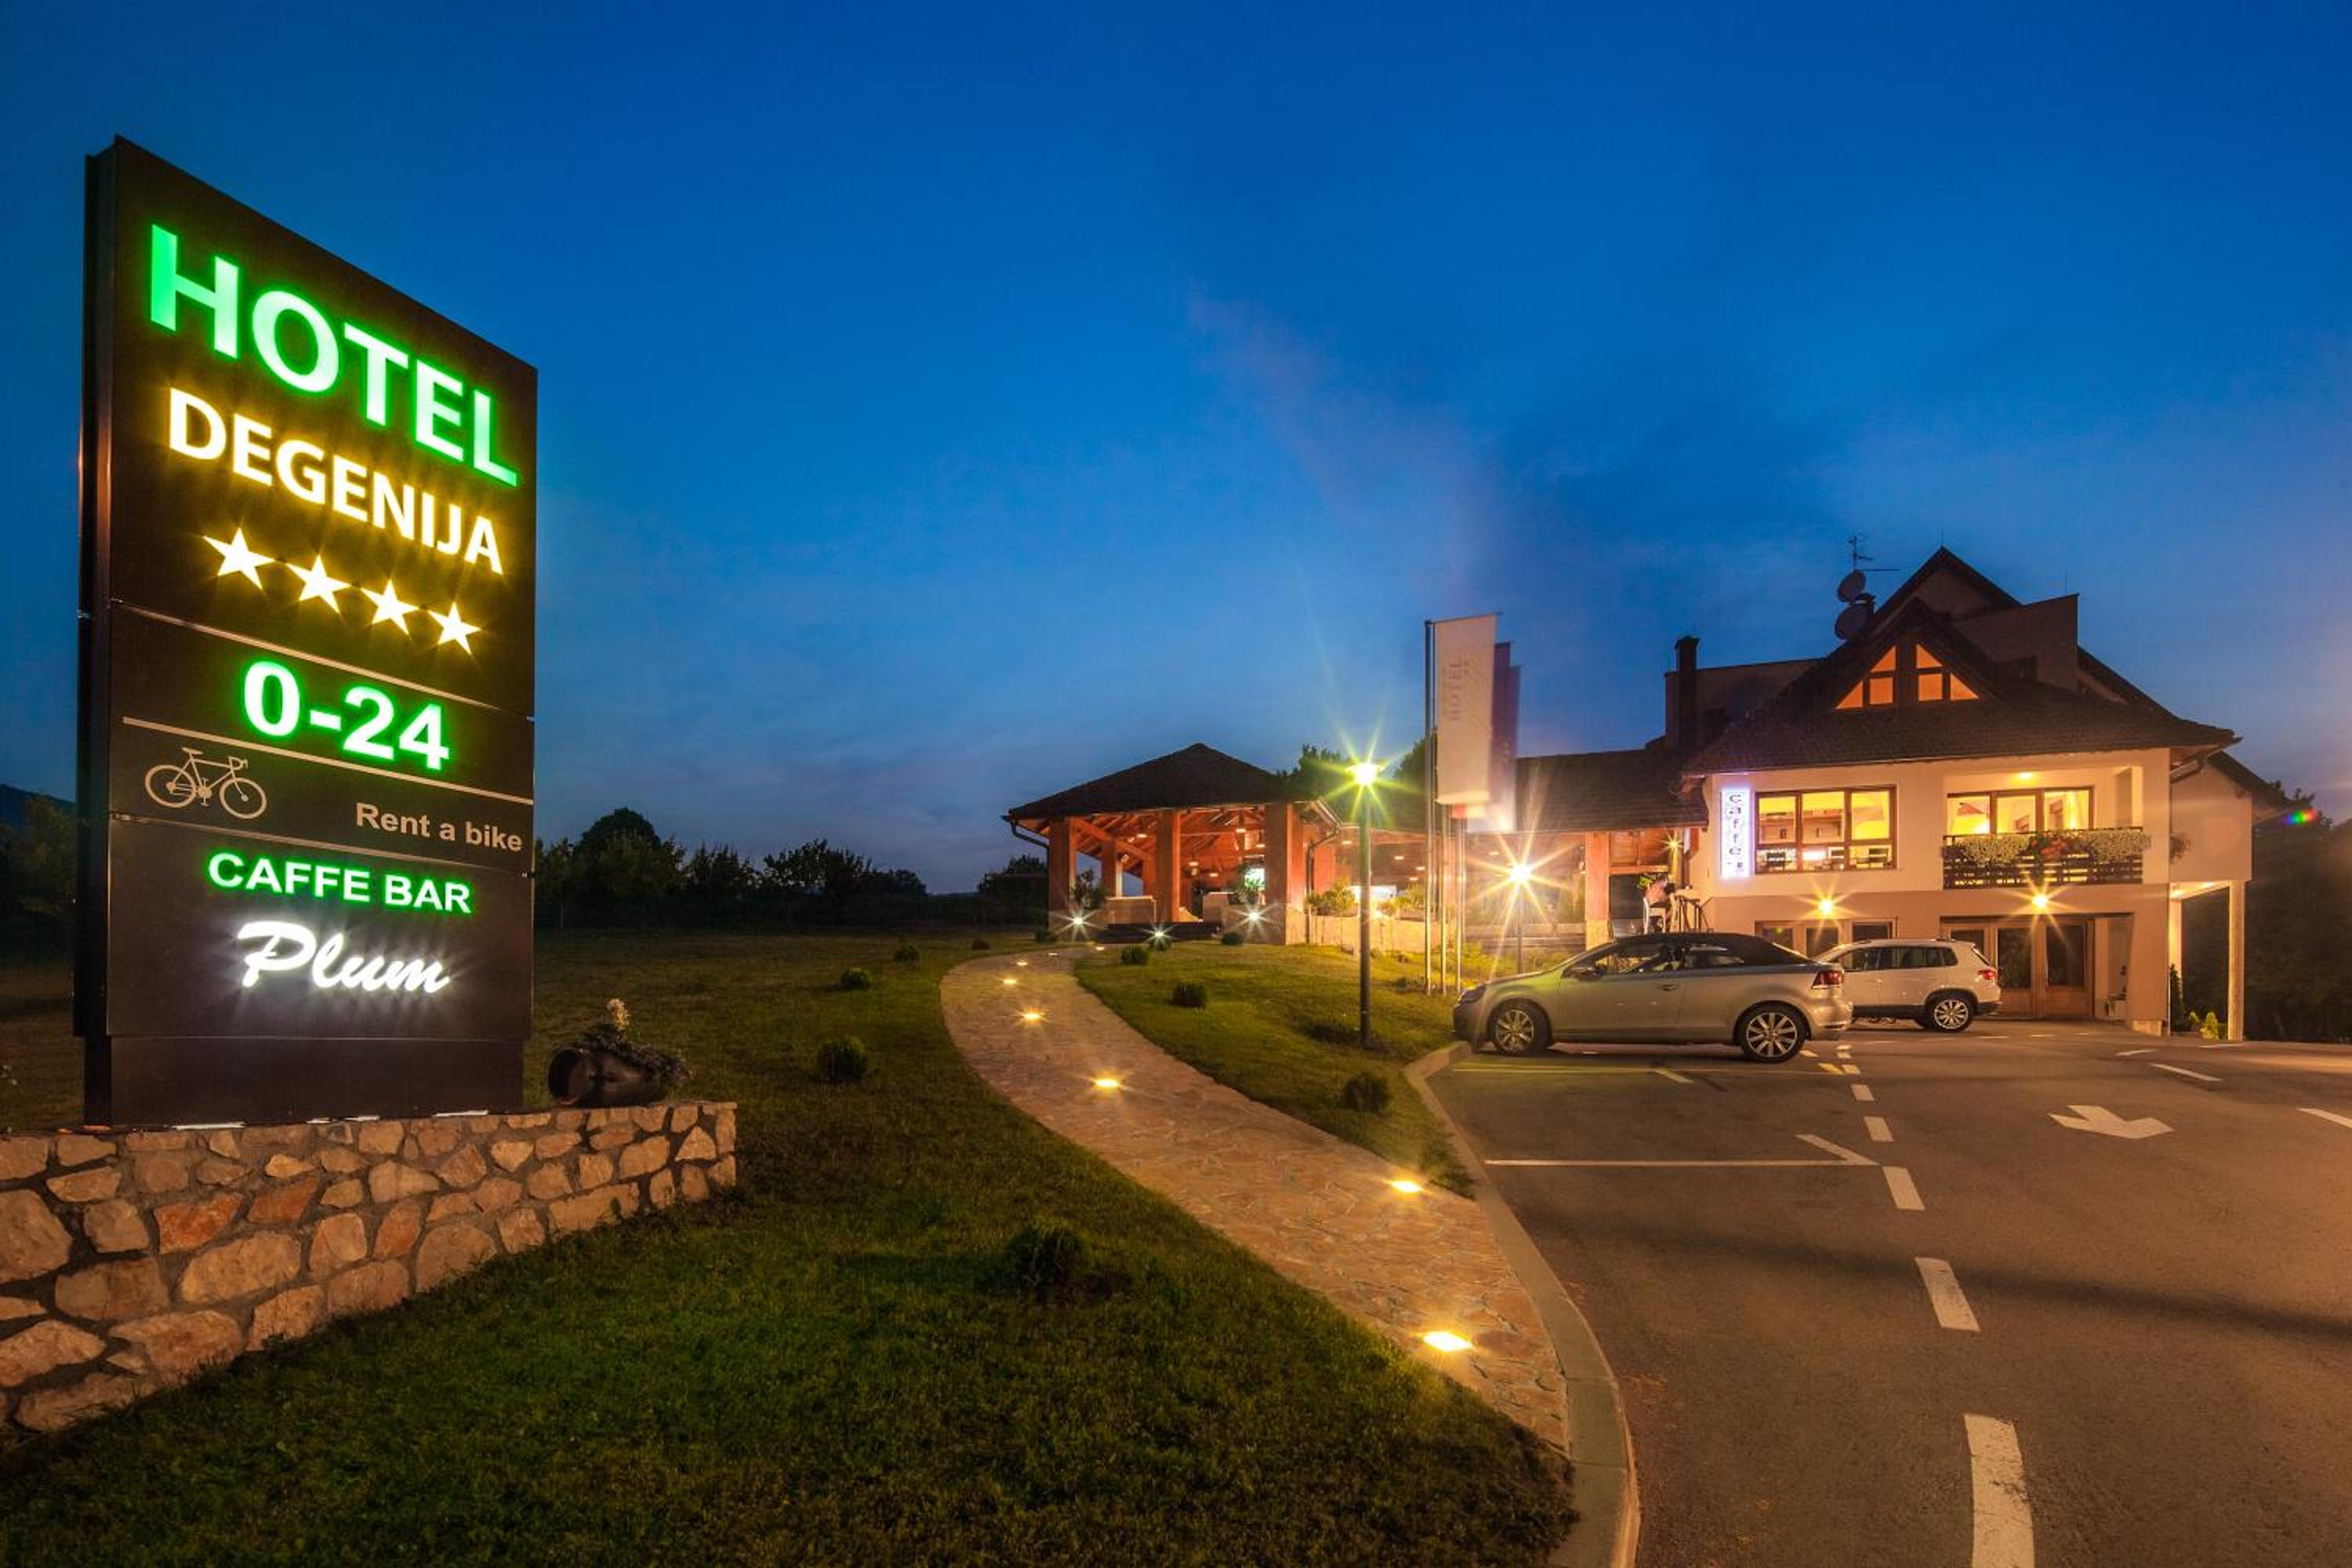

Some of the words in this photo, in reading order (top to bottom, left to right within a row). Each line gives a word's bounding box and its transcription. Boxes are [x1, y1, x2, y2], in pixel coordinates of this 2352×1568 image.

[151, 223, 517, 487] HOTEL
[169, 387, 503, 575] DEGENIJA
[244, 662, 450, 771] 0-24
[355, 802, 431, 839] Rent
[439, 822, 456, 842] a
[465, 821, 523, 852] bike
[208, 852, 371, 902] CAFFE
[384, 875, 471, 914] BAR
[238, 921, 450, 993] Plum
